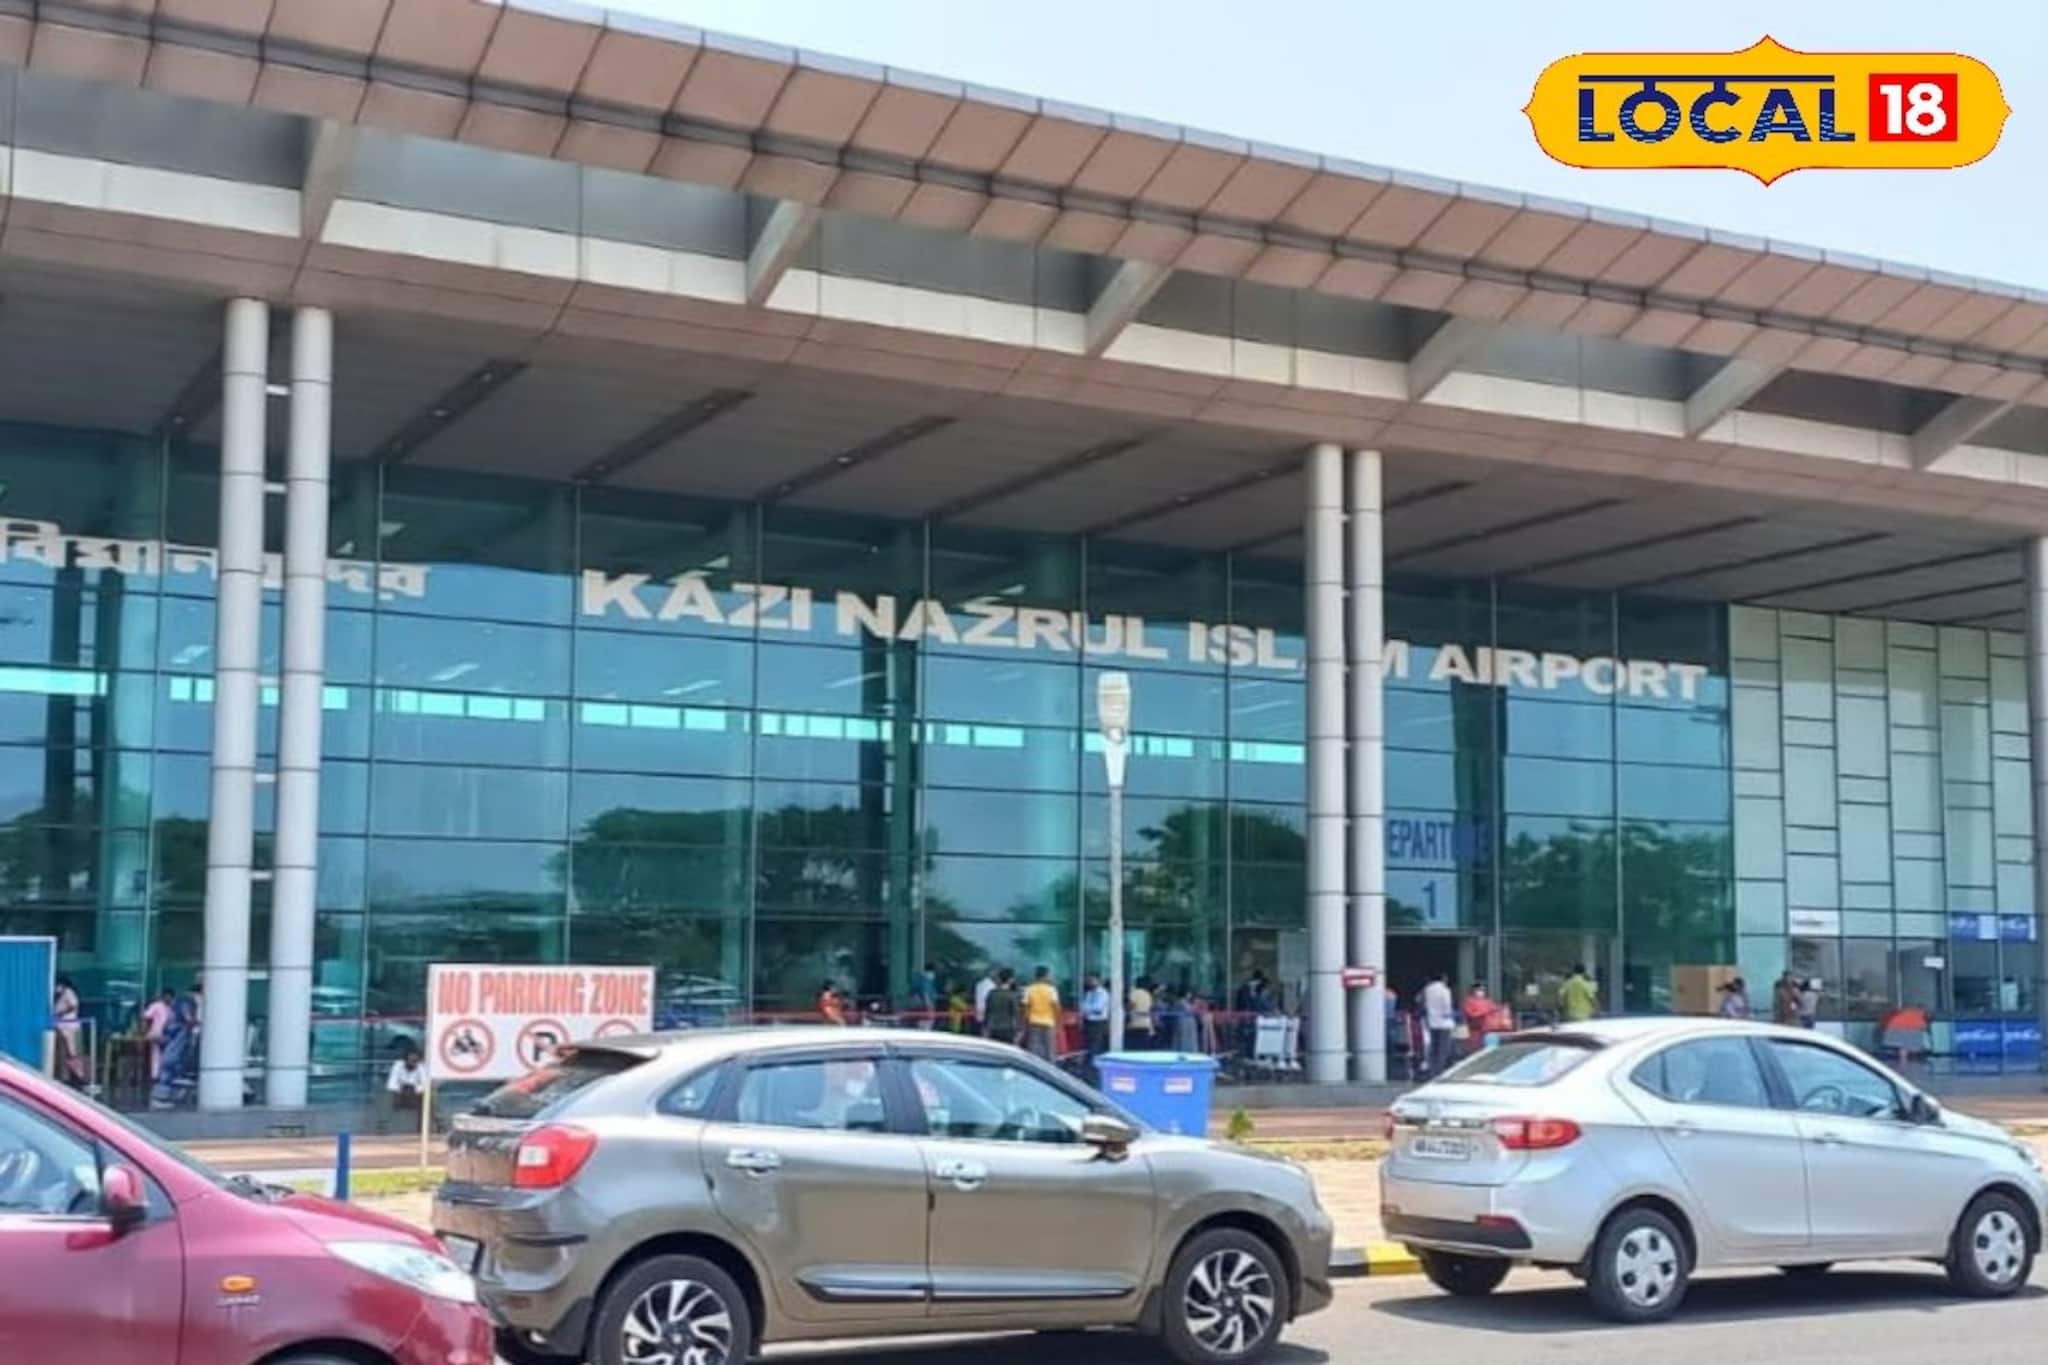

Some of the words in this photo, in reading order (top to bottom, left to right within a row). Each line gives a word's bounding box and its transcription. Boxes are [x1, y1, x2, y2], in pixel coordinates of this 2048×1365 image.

[581, 568, 812, 632] KAZI
[836, 590, 1167, 660] NAZRUL
[1189, 621, 1408, 679] ISLM
[1428, 643, 1708, 700] AIRPORT
[1388, 818, 1468, 861] EPART
[1421, 879, 1437, 919] 1
[437, 971, 472, 1014] NO
[479, 971, 584, 1015] PARKING
[588, 973, 650, 1016] ZONE
